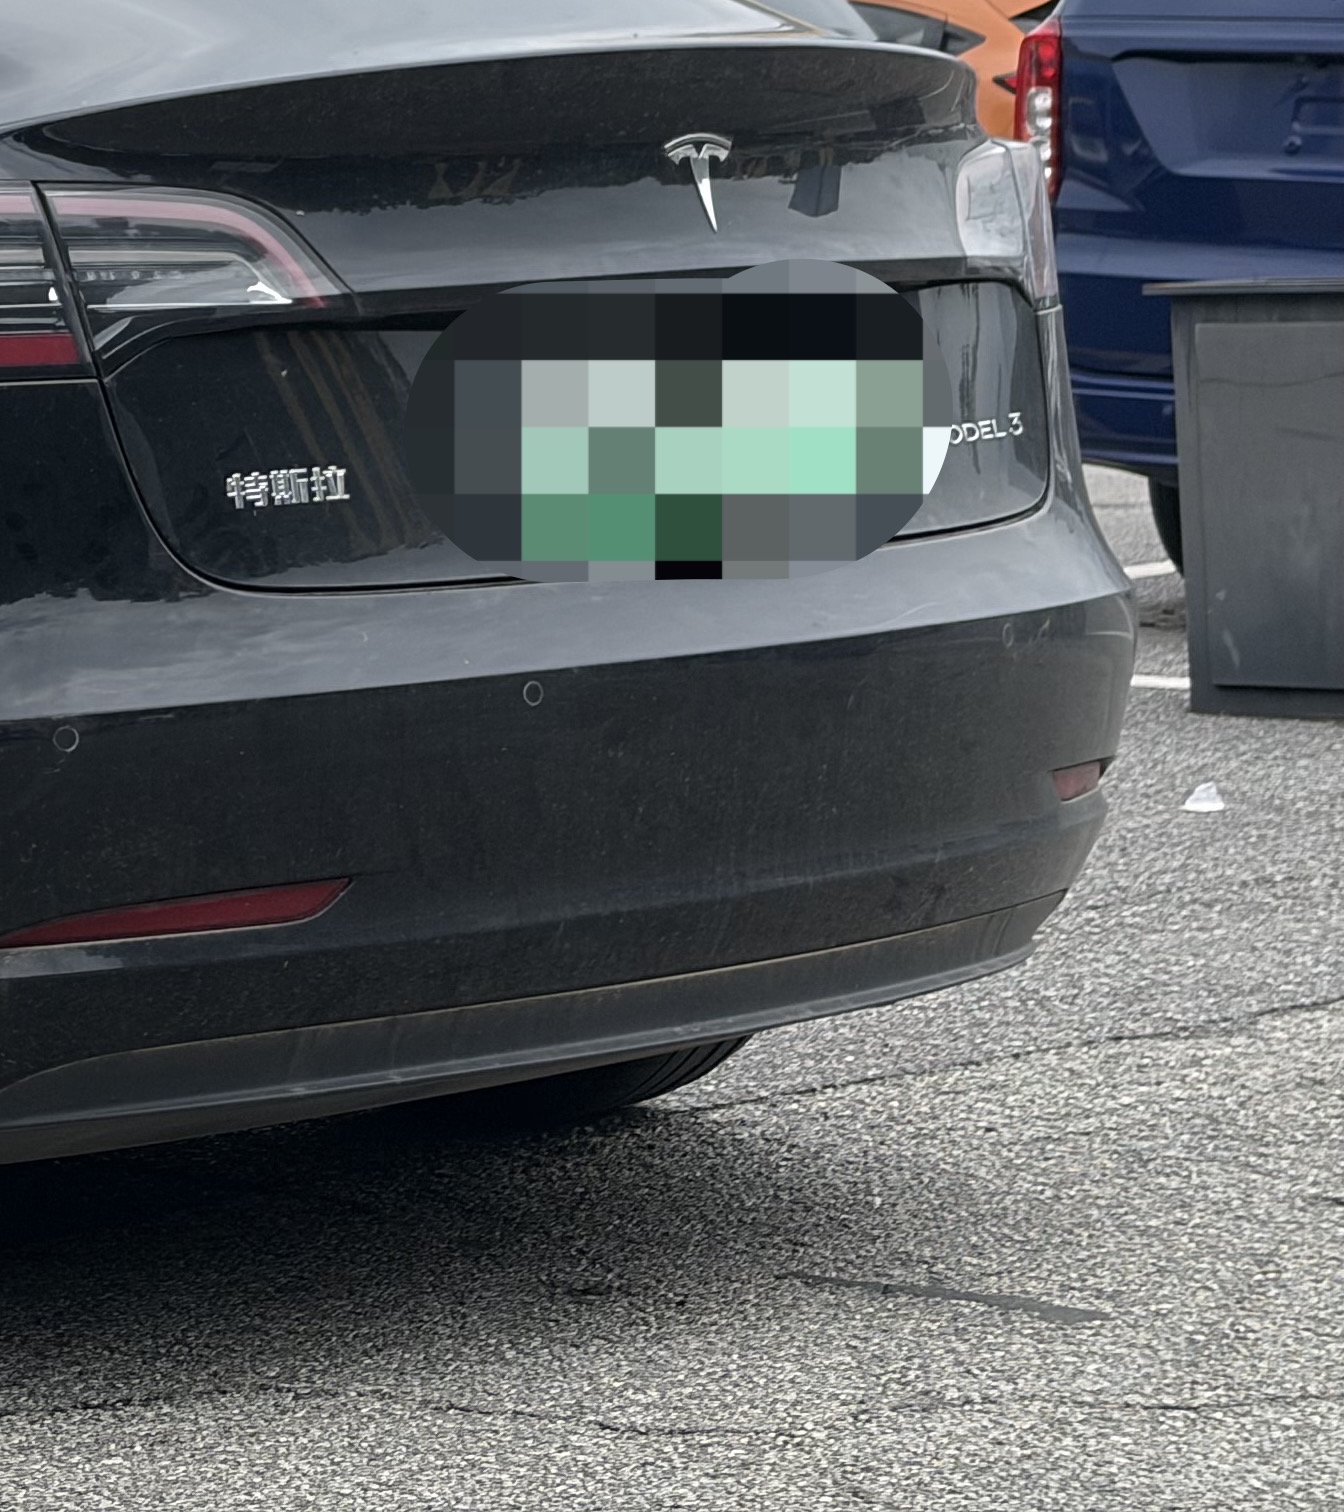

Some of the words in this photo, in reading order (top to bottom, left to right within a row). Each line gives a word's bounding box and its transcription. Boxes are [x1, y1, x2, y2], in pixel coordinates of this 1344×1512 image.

[1008, 411, 1024, 436] 3
[225, 465, 350, 510] 特斯拉
